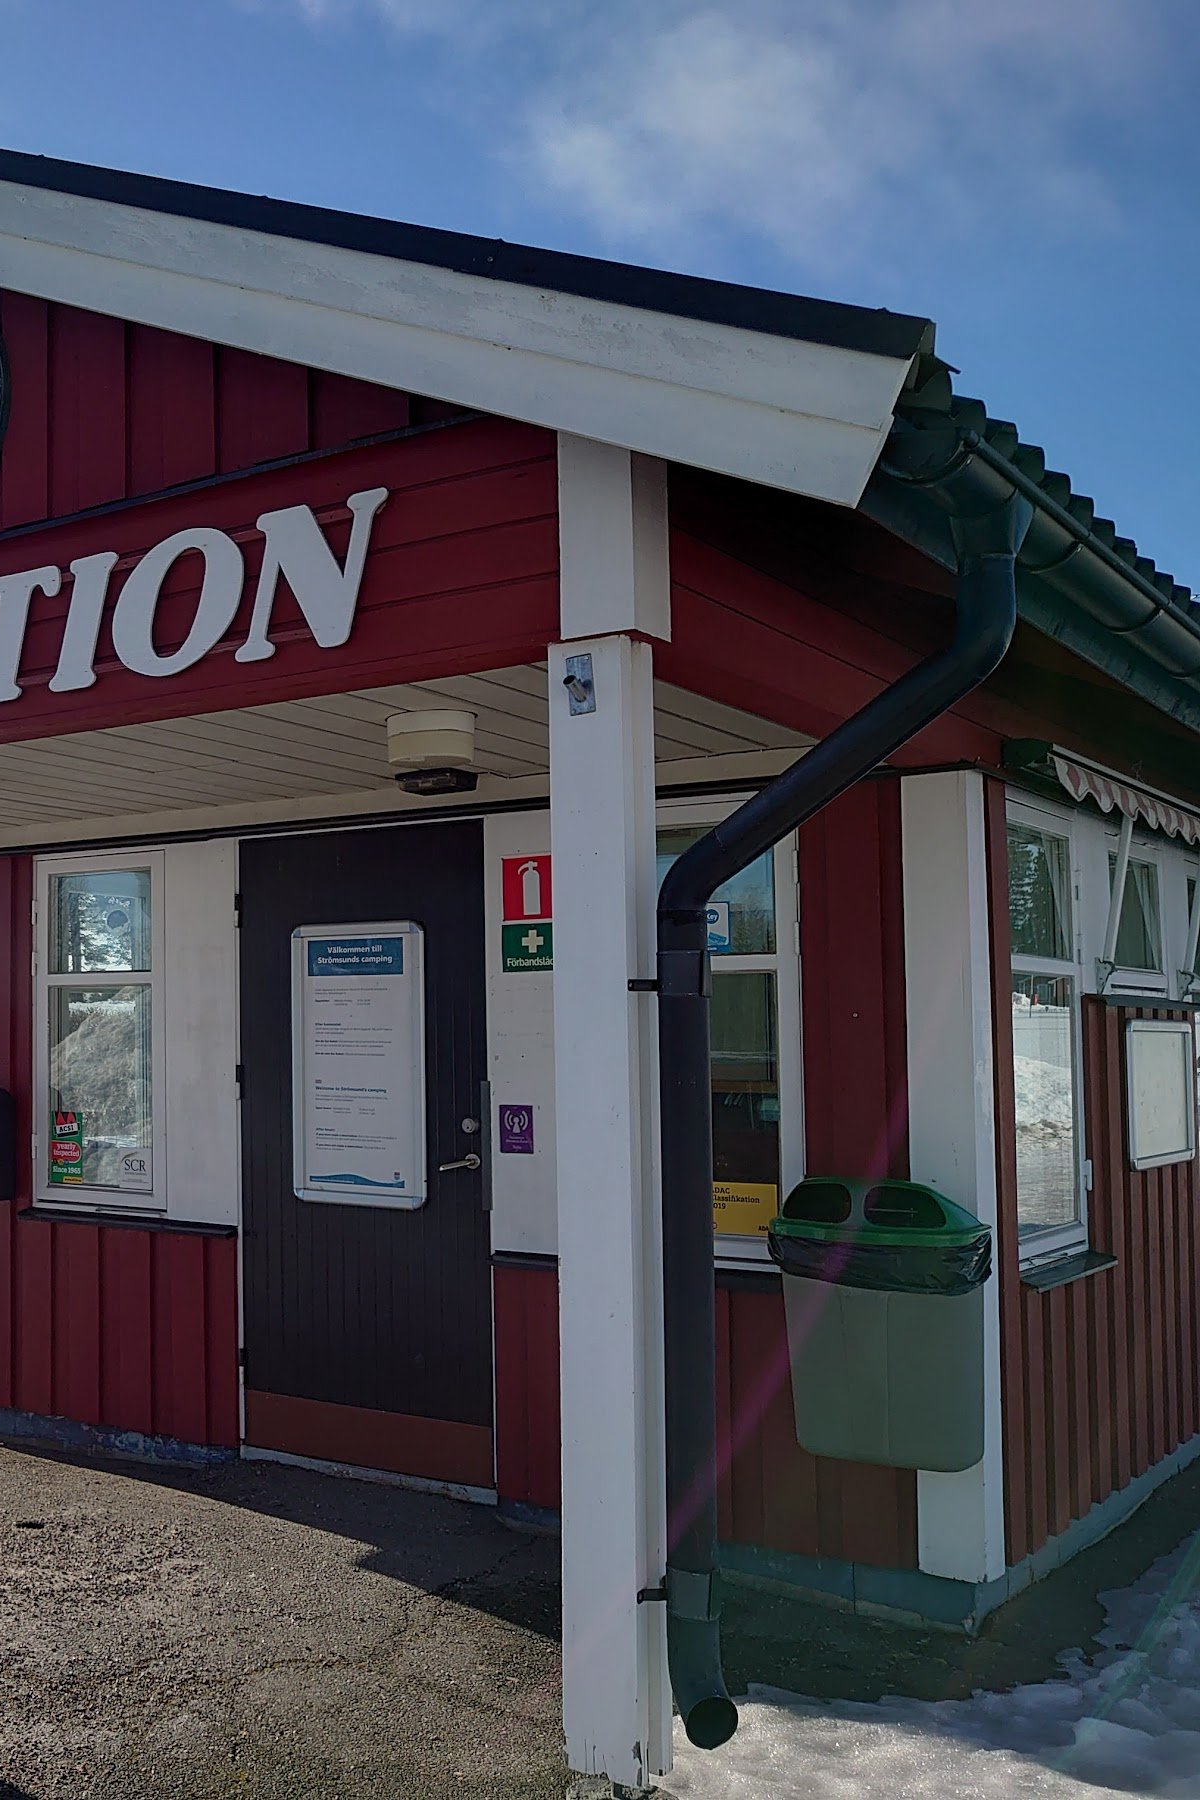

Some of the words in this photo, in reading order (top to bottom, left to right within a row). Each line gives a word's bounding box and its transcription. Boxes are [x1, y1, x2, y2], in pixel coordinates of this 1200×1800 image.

[327, 946, 370, 954] Välkommen
[372, 945, 382, 953] till
[318, 956, 359, 964] Strömsunds
[361, 955, 393, 963] camping
[56, 1143, 77, 1151] yearly
[124, 1159, 146, 1171] SCR
[68, 1167, 81, 1175] 1965
[713, 1194, 760, 1204] lassifikation
